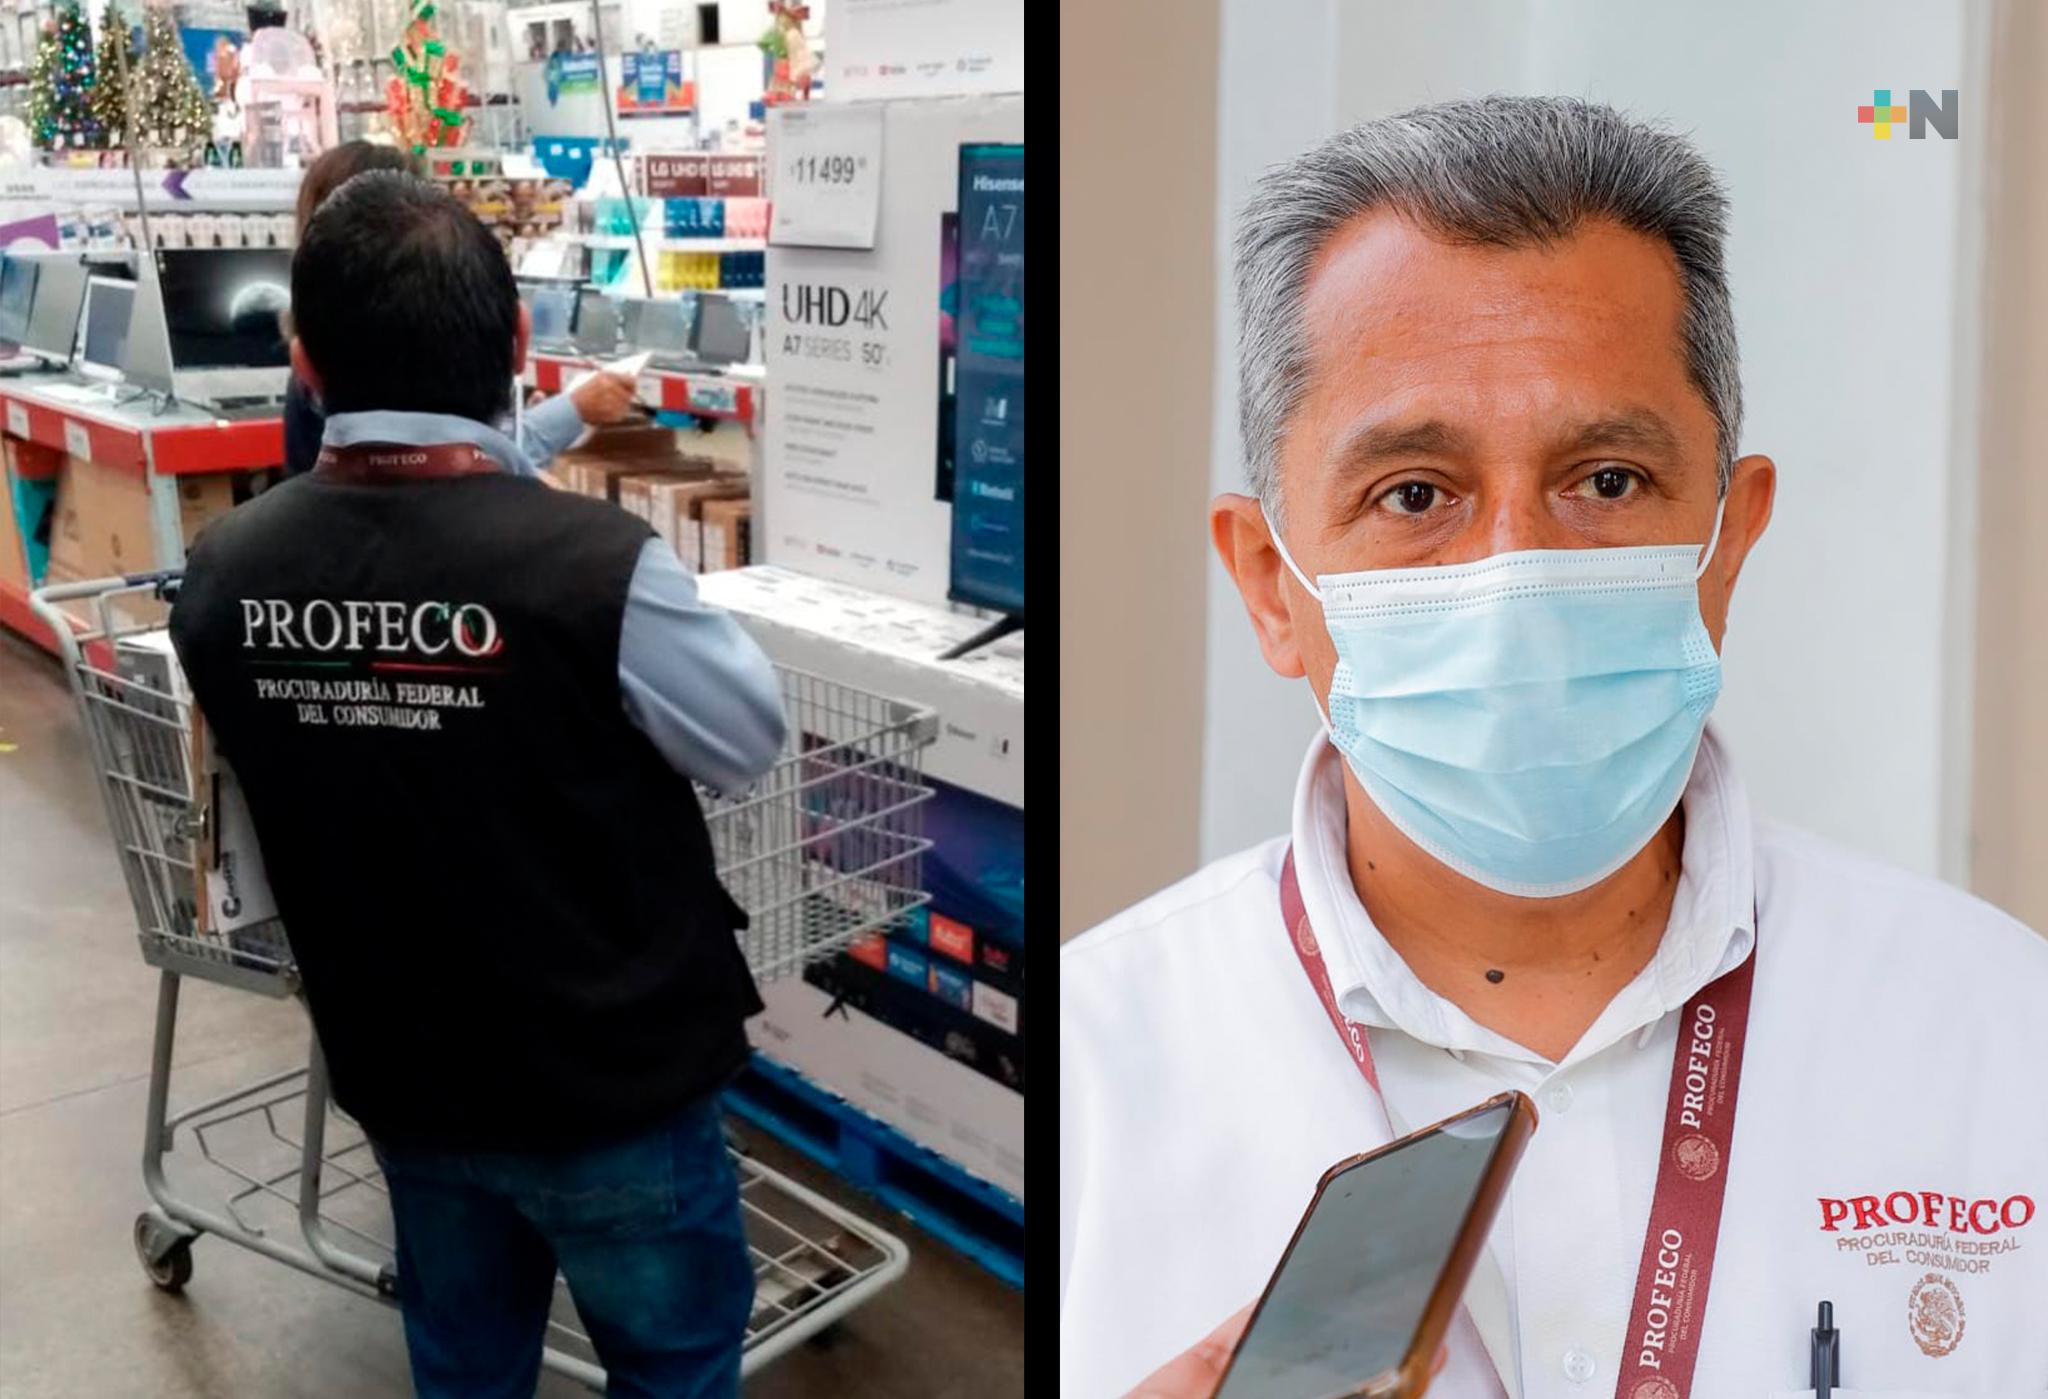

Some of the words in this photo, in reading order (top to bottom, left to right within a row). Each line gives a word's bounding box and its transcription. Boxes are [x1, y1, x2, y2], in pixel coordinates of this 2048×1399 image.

[981, 203, 1018, 240] A7
[782, 282, 850, 328] UHD
[853, 288, 889, 331] 4K
[783, 334, 802, 356] A7
[804, 336, 852, 362] SERIES
[240, 598, 501, 657] PROFECO
[255, 676, 391, 703] PROCURADURÍA
[396, 682, 484, 708] FEDERAL
[298, 704, 328, 725] DEL
[334, 705, 442, 730] CONSUMIDOR
[1680, 1003, 1716, 1130] PROFECO
[1817, 1190, 2036, 1235] PROFECO
[1836, 1231, 1953, 1253] PROCURADURÍA
[1955, 1236, 2022, 1256] FEDERAL
[1866, 1251, 1900, 1266] DEL
[1905, 1249, 1990, 1274] CONSUMIDOR
[1638, 1229, 1683, 1371] PROFECO
[1680, 1324, 1689, 1341] DEL
